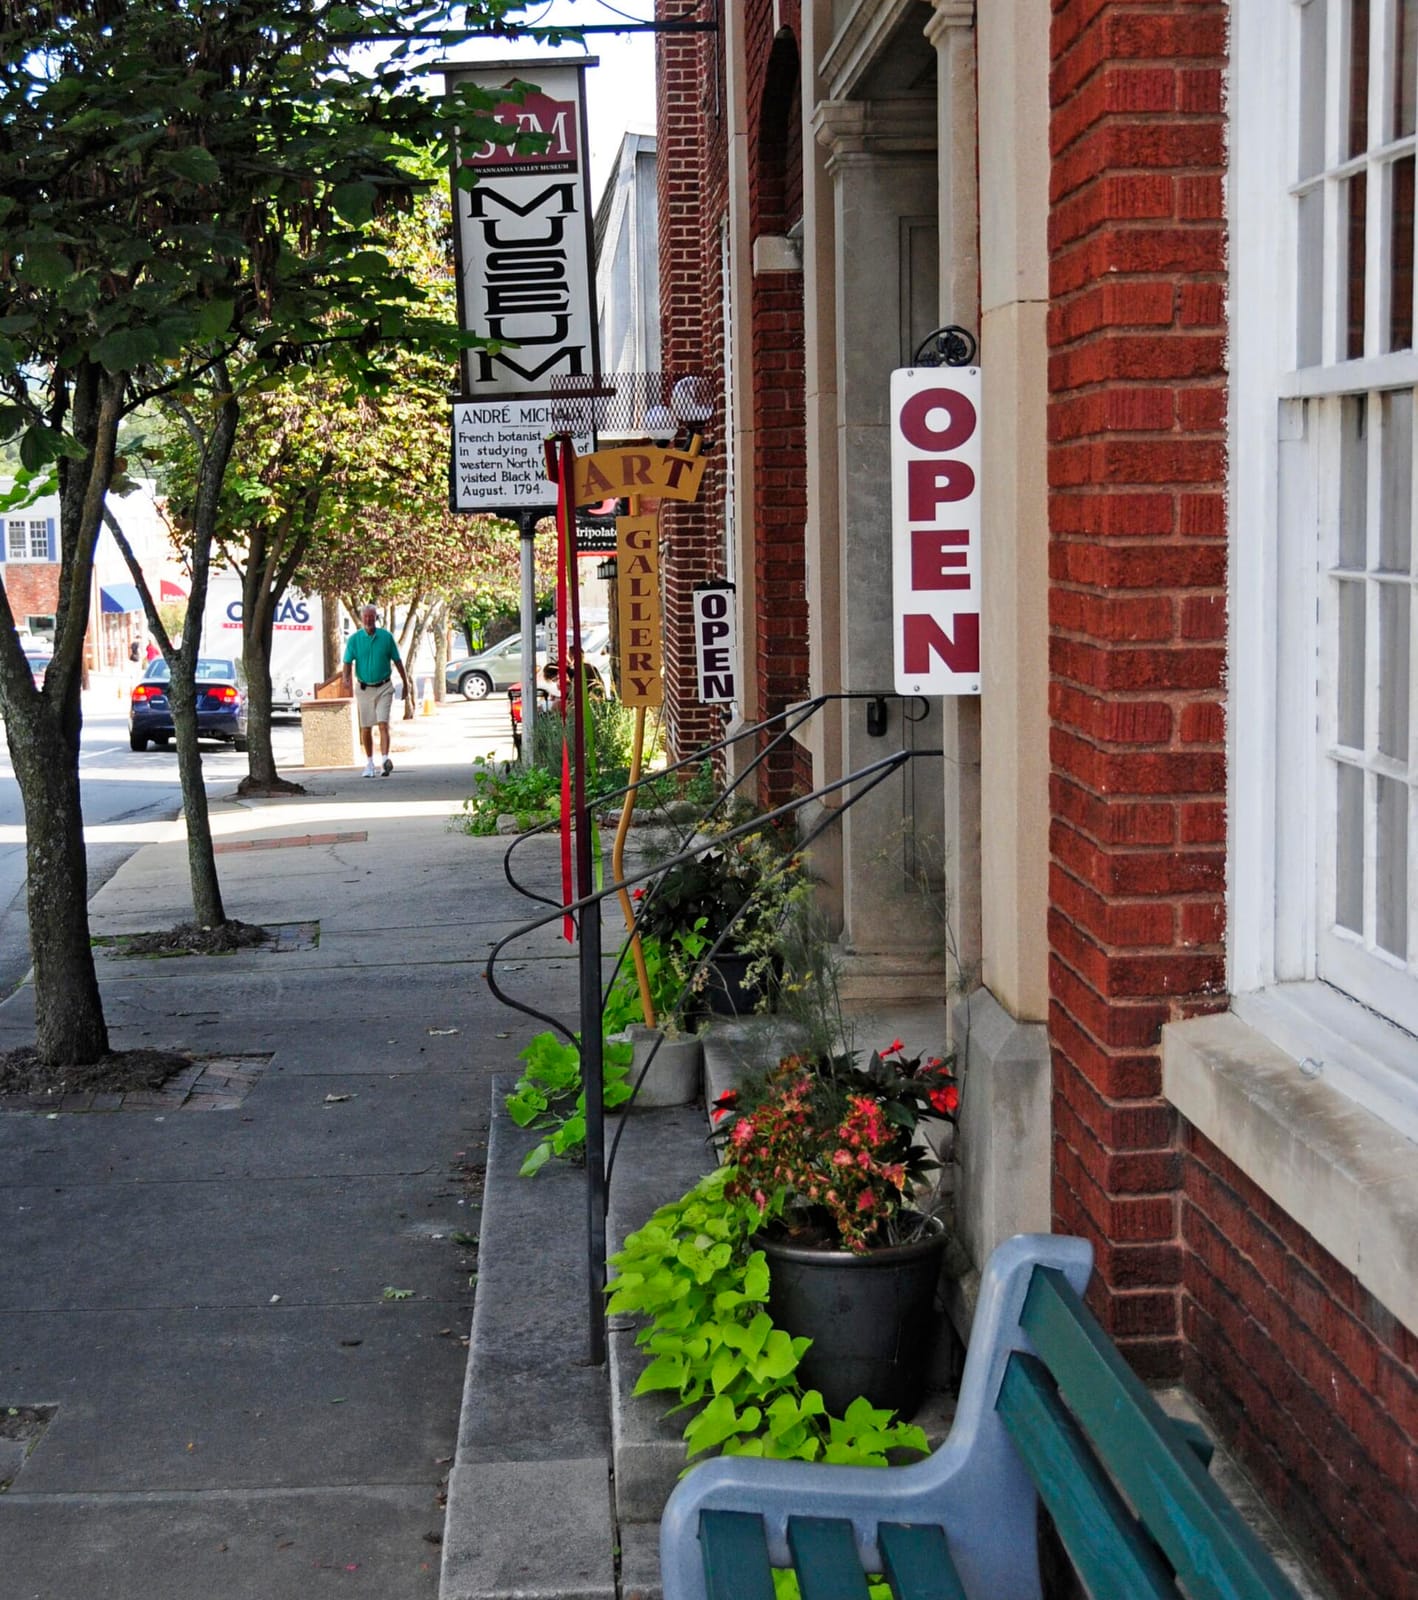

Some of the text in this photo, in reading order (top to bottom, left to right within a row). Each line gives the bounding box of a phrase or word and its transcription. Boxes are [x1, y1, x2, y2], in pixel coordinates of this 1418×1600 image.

[474, 166, 514, 174] WANNANOA
[467, 183, 587, 382] MUSEUM
[461, 405, 511, 425] ANDRÉ
[459, 432, 494, 443] French
[459, 446, 469, 456] in
[477, 444, 527, 458] studying
[578, 442, 589, 453] of
[460, 461, 503, 470] western
[507, 458, 538, 469] North
[460, 471, 496, 483] visited
[502, 470, 531, 482] Black
[582, 454, 695, 497] ART
[576, 526, 617, 539] ripolat
[900, 387, 980, 674] OPEN
[226, 596, 310, 623] CTAS
[625, 529, 657, 697] GALLERY
[701, 594, 735, 699] OPEN
